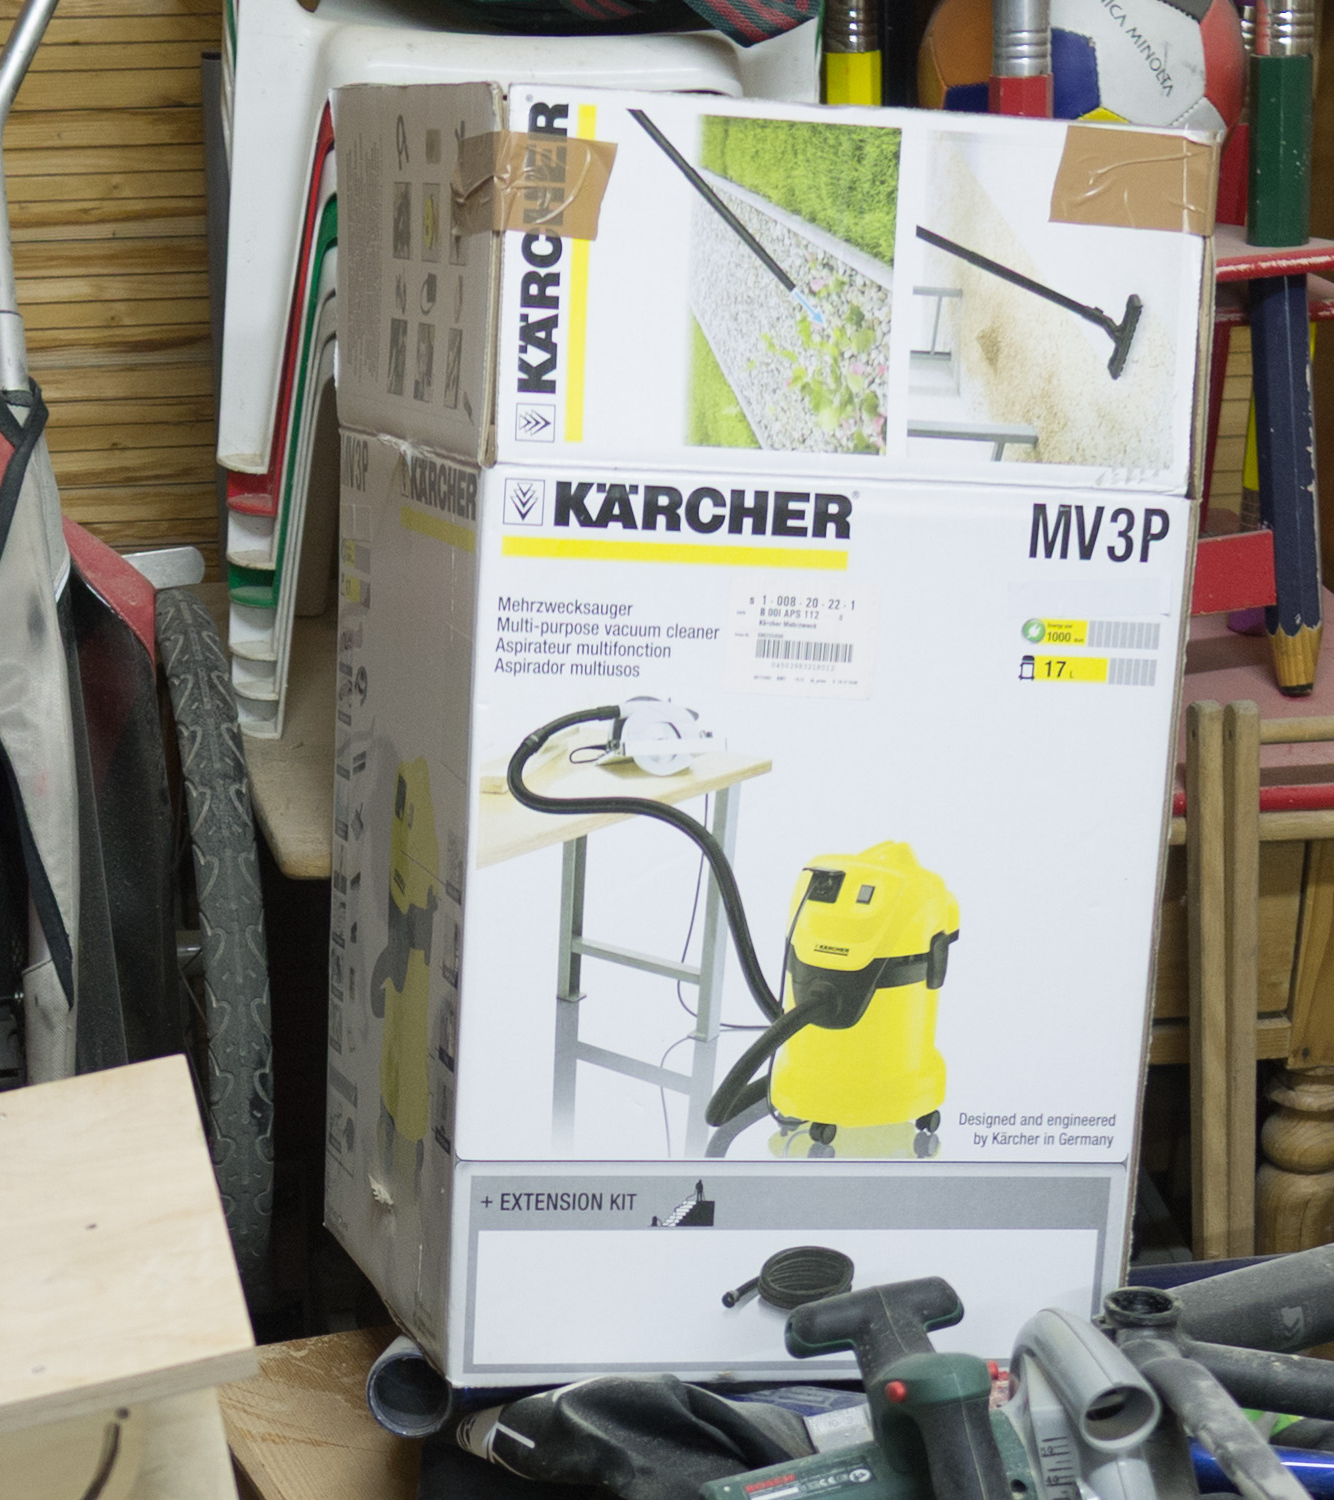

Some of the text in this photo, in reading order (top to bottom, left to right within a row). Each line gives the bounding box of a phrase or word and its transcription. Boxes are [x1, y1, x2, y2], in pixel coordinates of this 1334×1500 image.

[1100, 0, 1174, 97] ICA MINOLTA
[516, 101, 570, 394] KÄRCHER
[553, 480, 854, 540] KÄRCHER
[1028, 503, 1171, 563] MV3P
[496, 596, 634, 620] Mehrzwecksauger
[783, 609, 801, 619] APS
[804, 610, 820, 620] 112
[496, 617, 721, 640] Multi-purpose vacuum cleaner
[1046, 631, 1072, 643] 1000
[495, 637, 672, 659] Aspirateur multifonction
[494, 657, 641, 678] Aspirador multiusos
[1044, 660, 1067, 678] 17
[958, 1112, 1116, 1129] Designed and engineered
[973, 1131, 1115, 1149] by Kärcher in Germany
[499, 1192, 604, 1212] EXTENSION
[609, 1193, 638, 1211] KIT
[1045, 1474, 1060, 1485] 40
